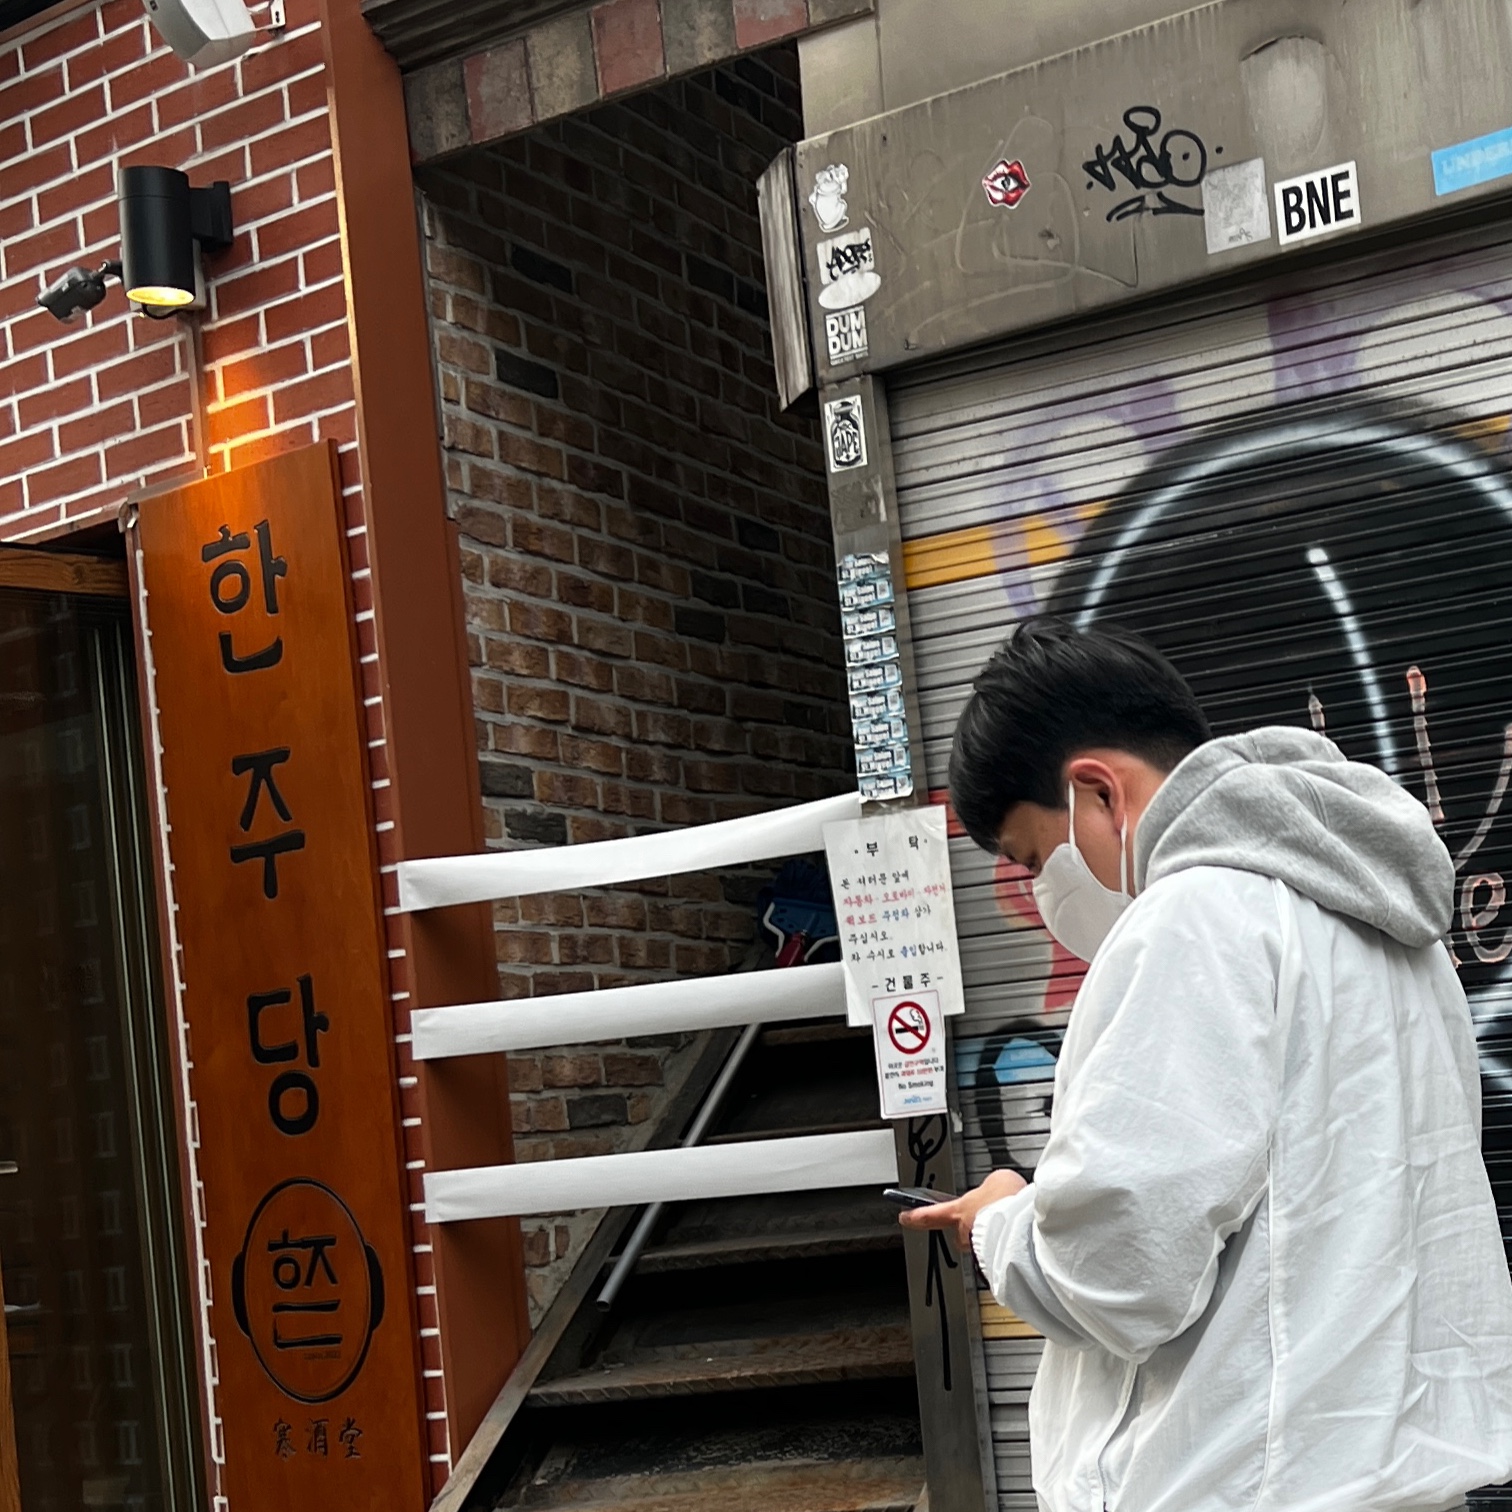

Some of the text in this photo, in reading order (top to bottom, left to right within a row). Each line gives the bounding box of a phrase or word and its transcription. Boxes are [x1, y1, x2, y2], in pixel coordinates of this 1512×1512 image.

[1282, 171, 1354, 236] BNE
[826, 313, 865, 338] DUM
[828, 328, 868, 356] DUM
